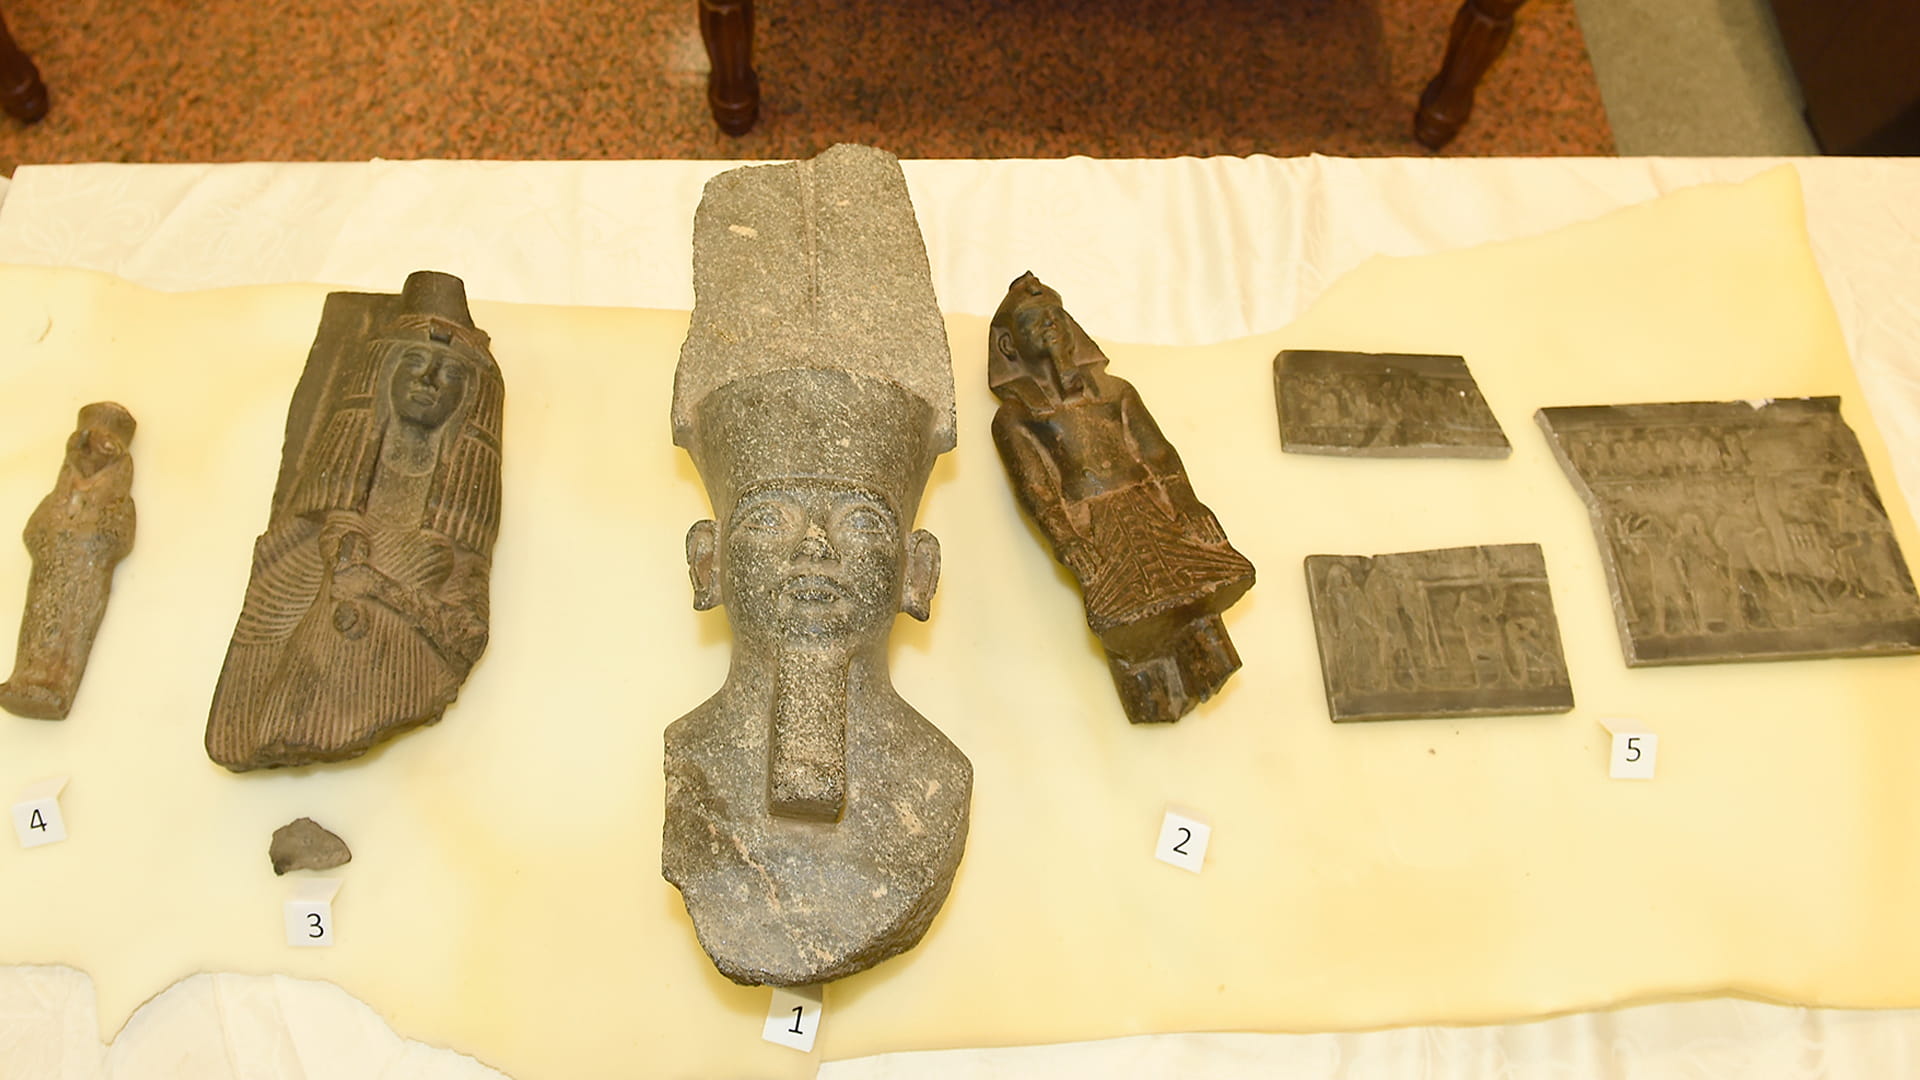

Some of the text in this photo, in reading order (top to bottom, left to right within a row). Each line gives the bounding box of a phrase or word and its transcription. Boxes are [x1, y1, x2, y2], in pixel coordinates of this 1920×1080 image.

[1626, 738, 1641, 762] 5
[30, 808, 47, 832] 4
[1173, 827, 1191, 855] 2
[307, 913, 324, 938] 3
[788, 1005, 804, 1035] 1
